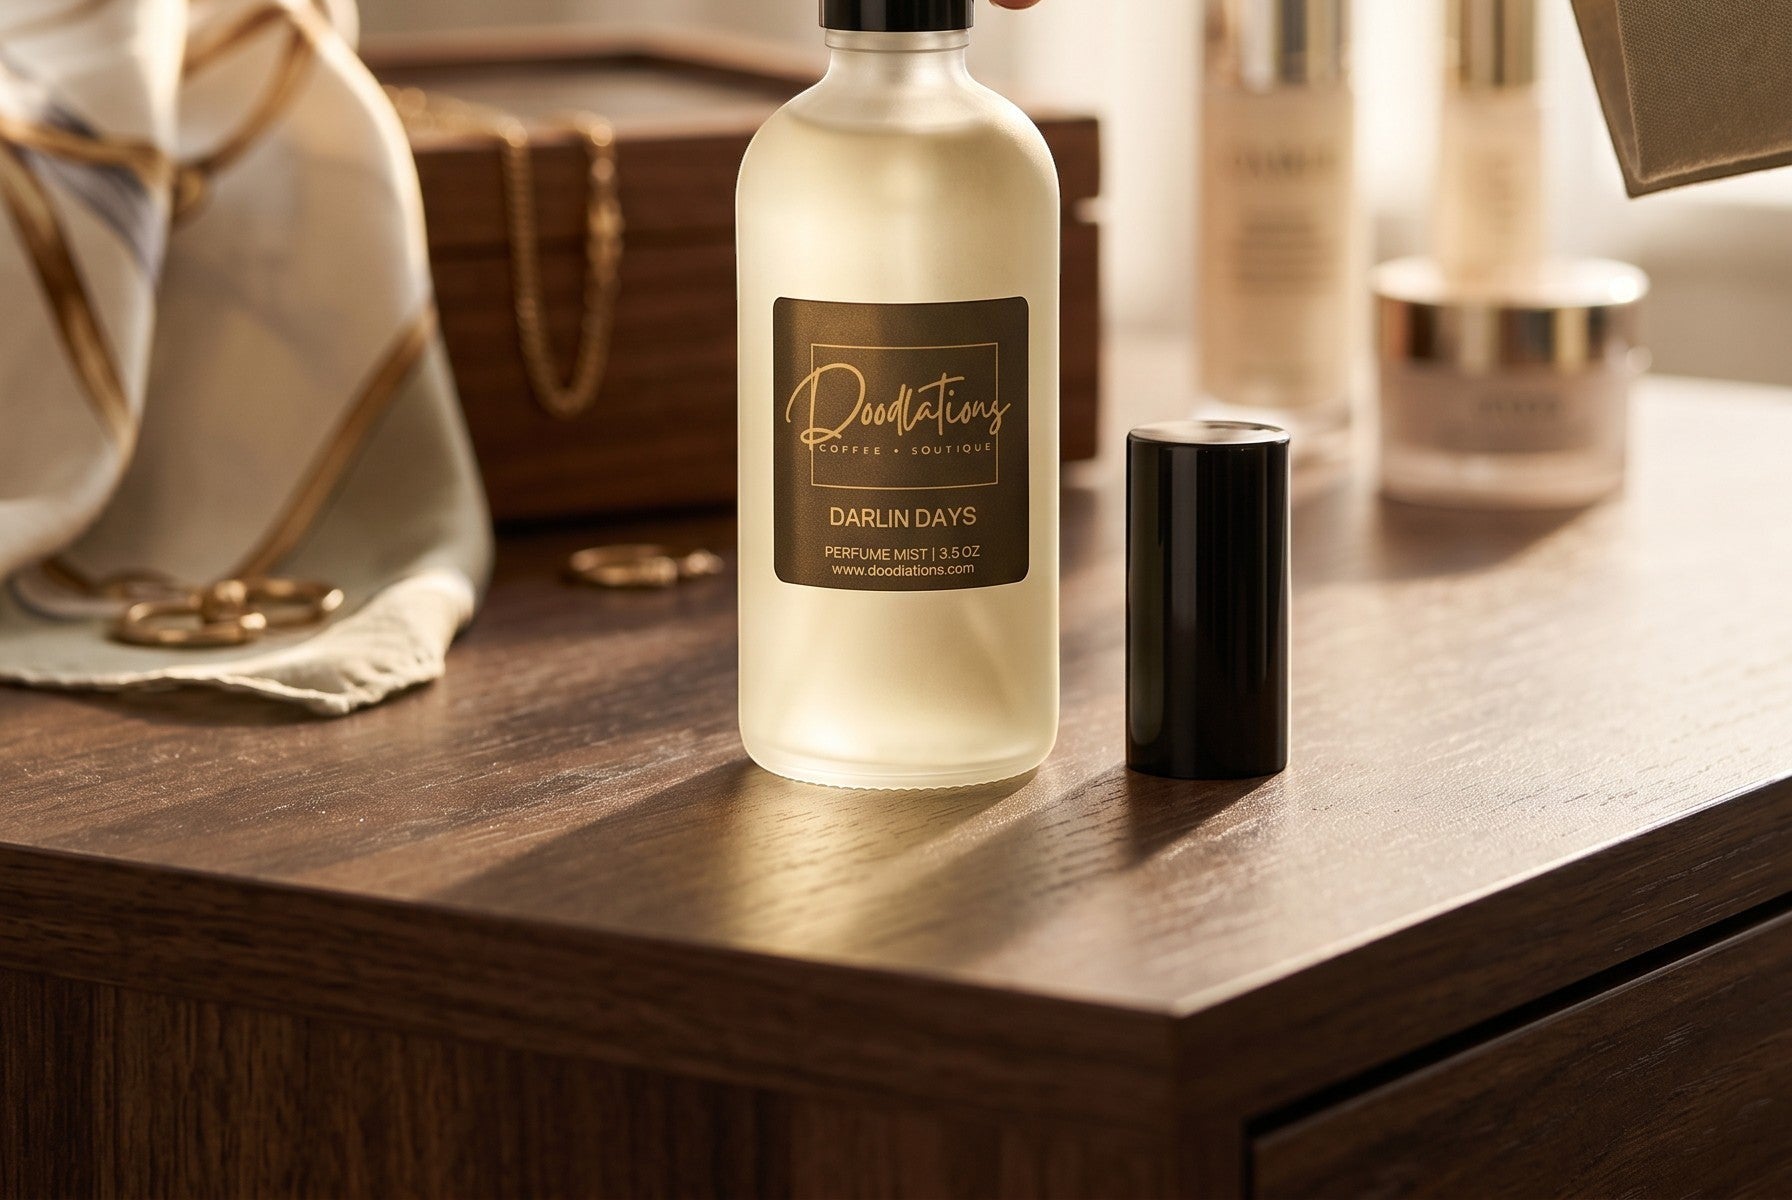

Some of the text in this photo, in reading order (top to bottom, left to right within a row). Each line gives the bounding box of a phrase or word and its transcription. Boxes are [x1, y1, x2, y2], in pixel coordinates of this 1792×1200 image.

[785, 362, 1011, 451] Doodlations
[819, 442, 991, 455] COFFEE SOUTIQUE
[830, 506, 977, 528] DARLIN DAYS
[825, 545, 891, 560] PERFUME
[894, 547, 928, 560] MIST
[939, 546, 960, 560] 3.5
[961, 544, 980, 558] OZ
